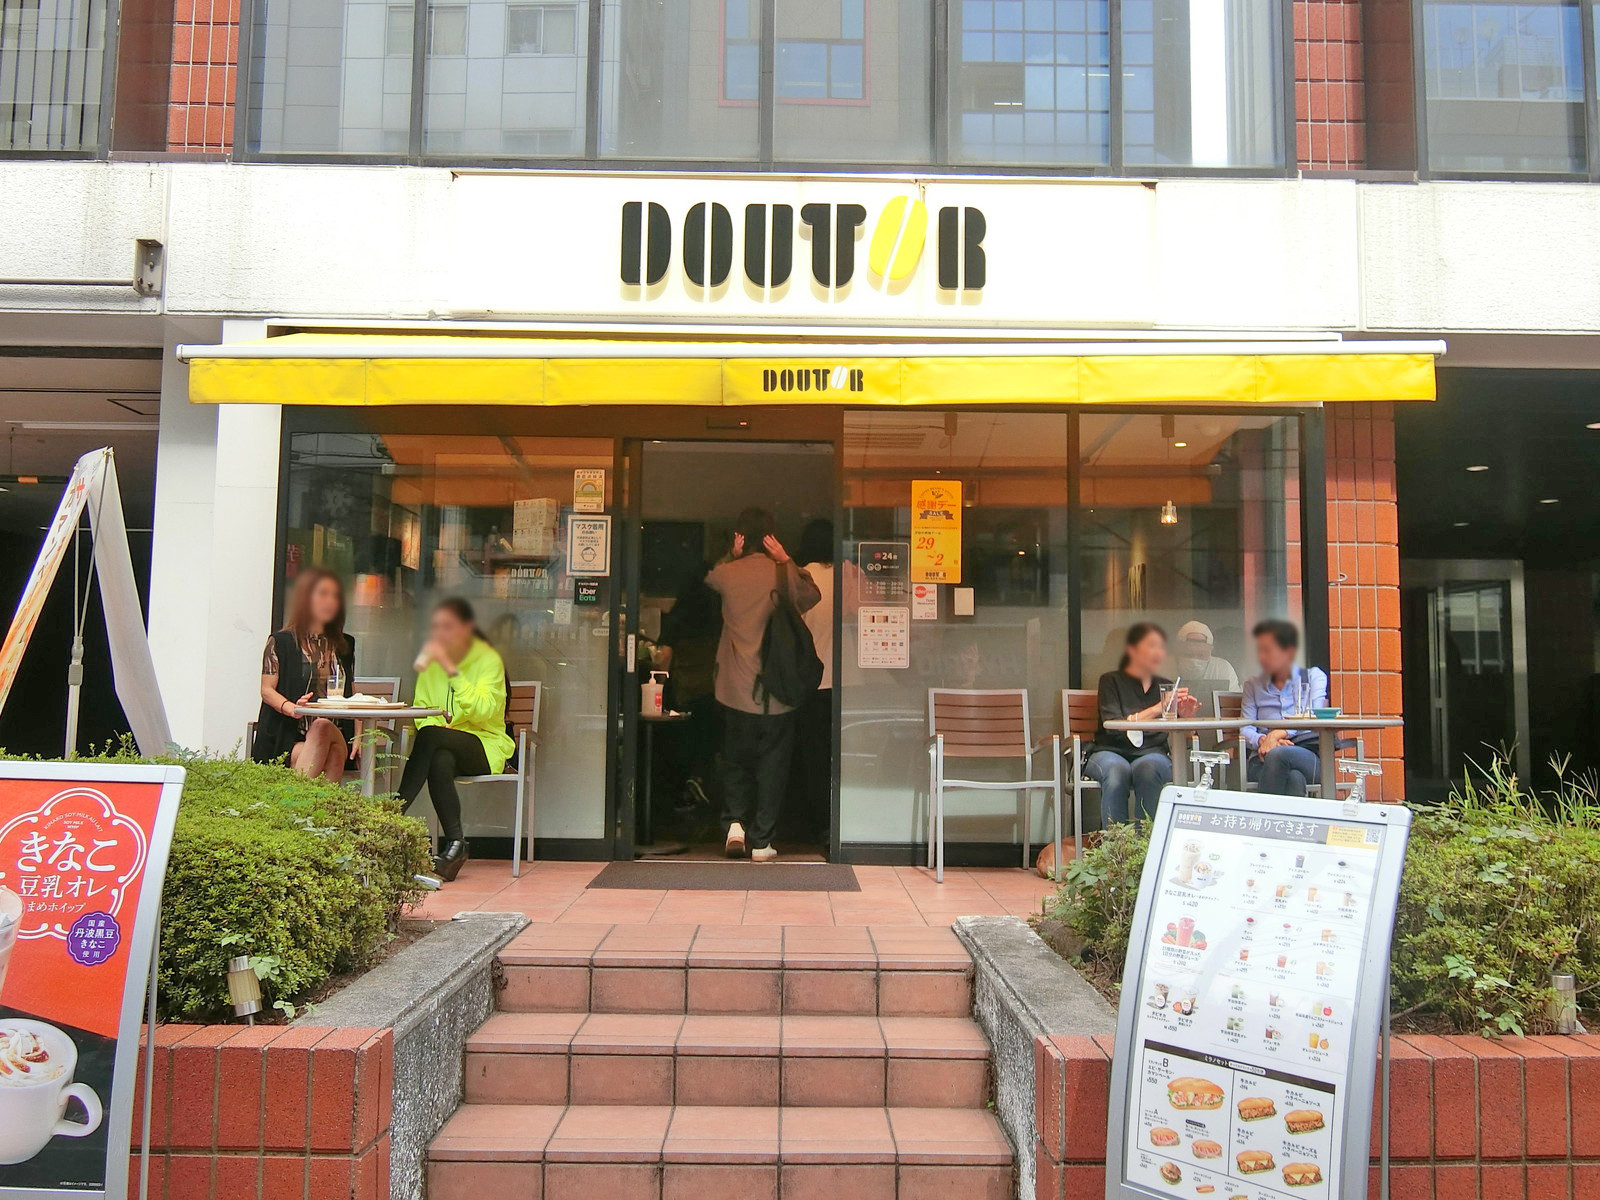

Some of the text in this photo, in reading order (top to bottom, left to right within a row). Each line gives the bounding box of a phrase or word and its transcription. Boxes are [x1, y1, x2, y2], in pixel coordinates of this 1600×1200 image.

[620, 195, 987, 291] DOUTOR
[763, 364, 864, 392] DOUTOR
[575, 523, 605, 531] マスク着用
[916, 537, 935, 550] 29
[579, 587, 597, 595] Uber
[1210, 813, 1319, 837] お持ち帰りできます
[17, 831, 118, 872] きなこ
[18, 874, 108, 898] 豆乳オレ
[27, 900, 87, 914] まめホイップ
[74, 928, 115, 939] 丹波黒豆
[80, 939, 106, 949] きなこ
[82, 950, 100, 958] 使用
[1162, 1058, 1169, 1068] B
